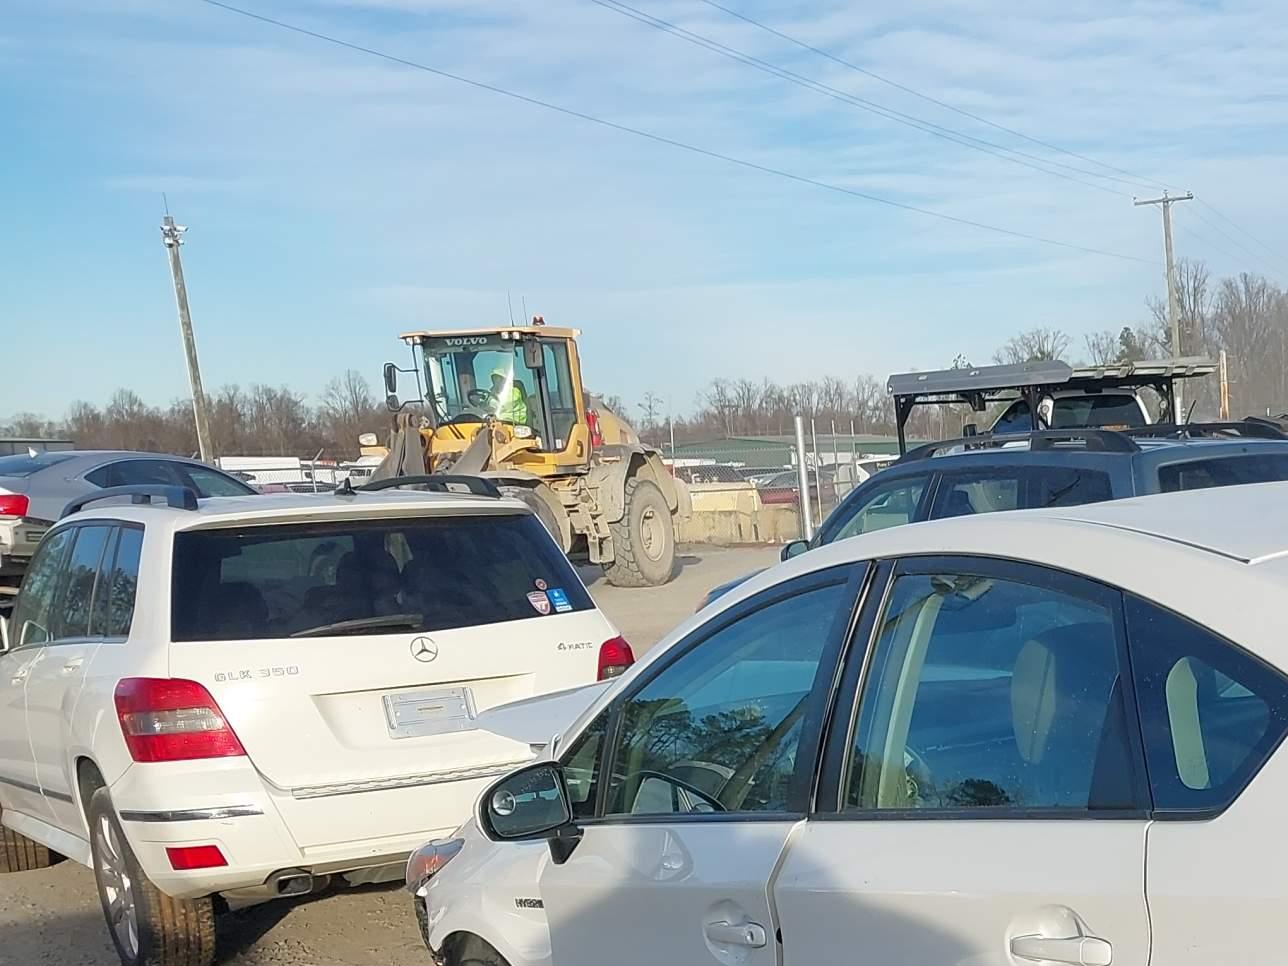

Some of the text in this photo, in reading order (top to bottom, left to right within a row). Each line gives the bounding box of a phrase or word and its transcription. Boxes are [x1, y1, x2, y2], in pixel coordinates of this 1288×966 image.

[445, 336, 488, 346] VOLVO
[214, 666, 299, 682] GLK 350
